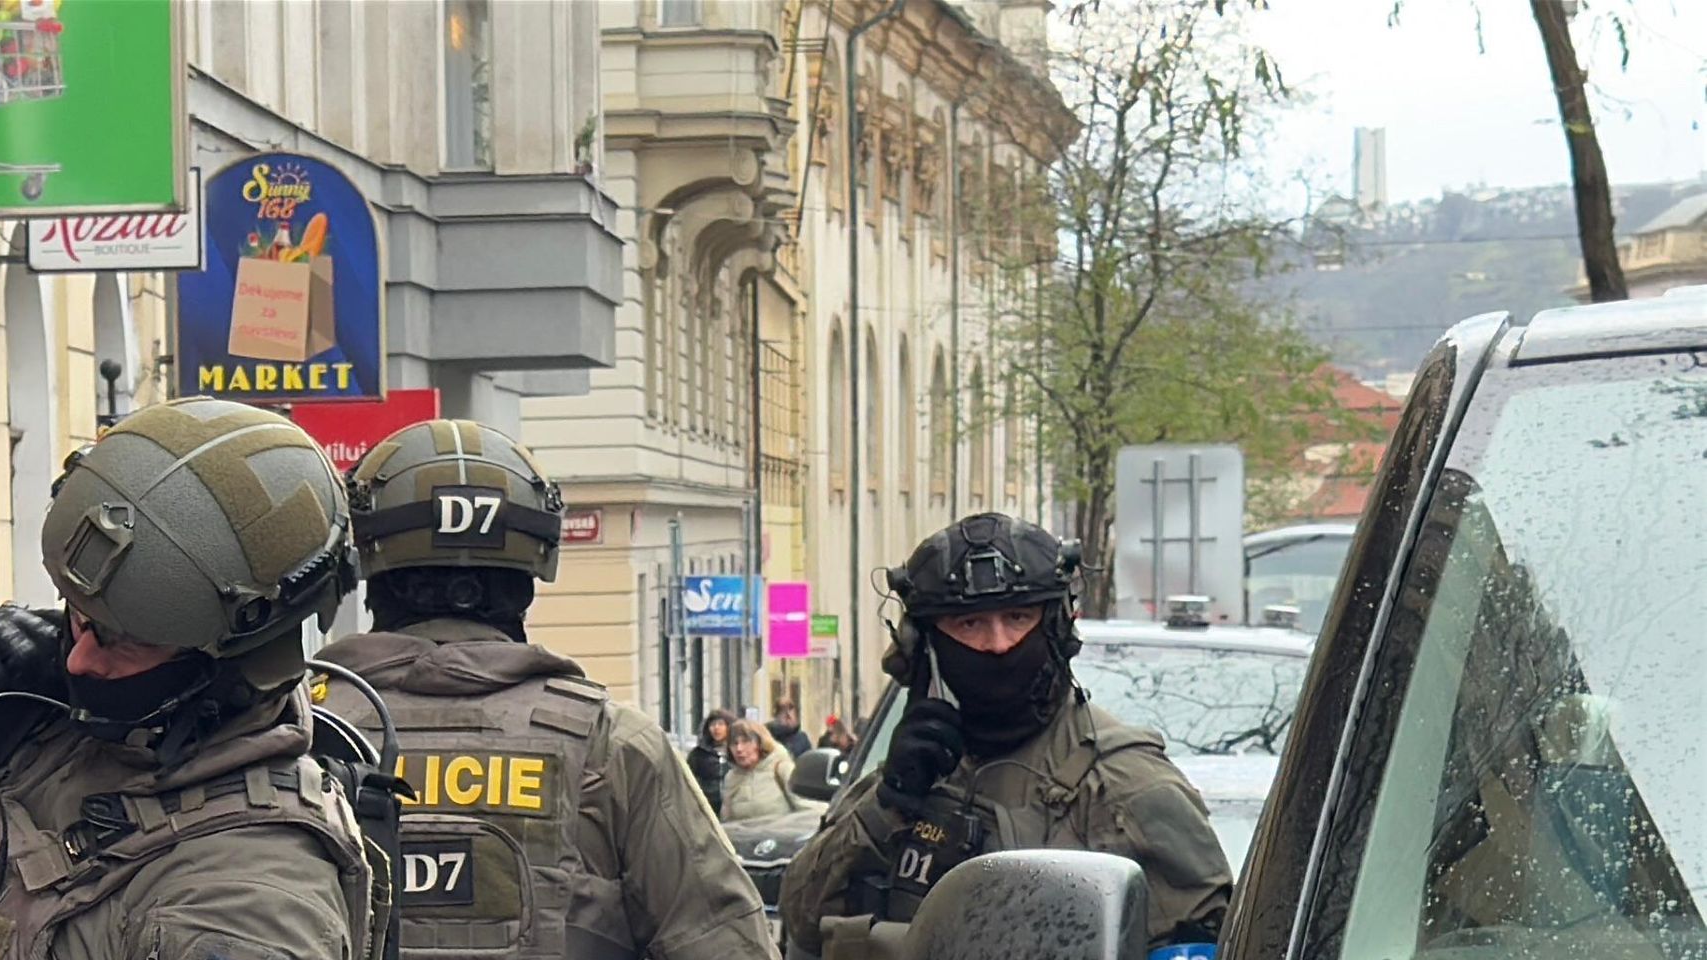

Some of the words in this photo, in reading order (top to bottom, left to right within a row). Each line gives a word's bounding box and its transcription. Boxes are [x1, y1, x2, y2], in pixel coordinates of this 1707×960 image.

[243, 164, 311, 202] Sunny
[94, 243, 150, 256] BOUTIQUE
[199, 363, 353, 391] MARKET
[437, 496, 501, 534] D7
[403, 852, 467, 892] D7
[898, 848, 934, 884] D1
